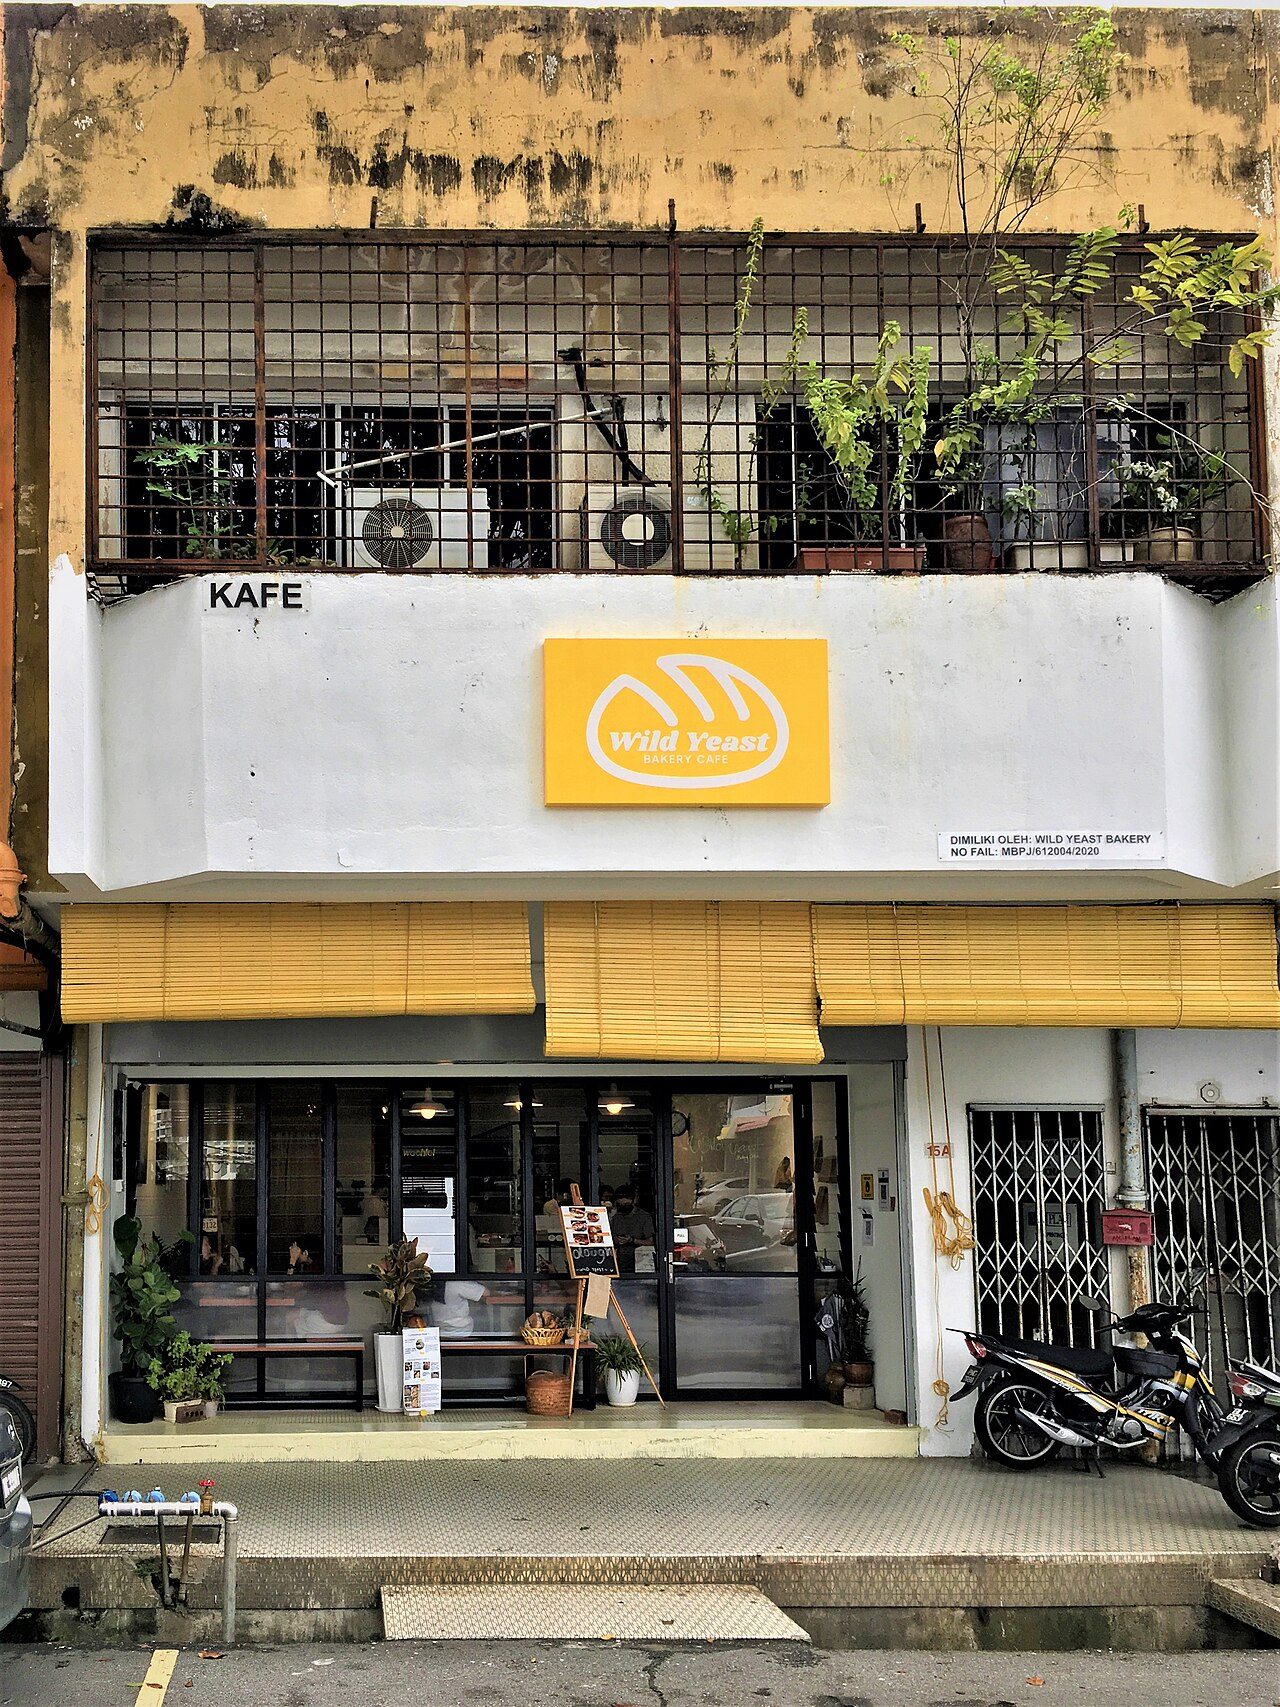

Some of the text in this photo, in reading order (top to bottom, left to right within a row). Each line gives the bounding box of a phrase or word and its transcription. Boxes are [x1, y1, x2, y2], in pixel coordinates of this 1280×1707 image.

[210, 582, 303, 609] KAFE
[610, 730, 771, 753] Wild Yeast
[643, 754, 729, 764] BAKERY CAFE
[950, 834, 1152, 845] DIMILIKI OLEH: WILD YEAST BAKERY
[950, 847, 1100, 857] NO FAIL: MBPJ/612004/2020
